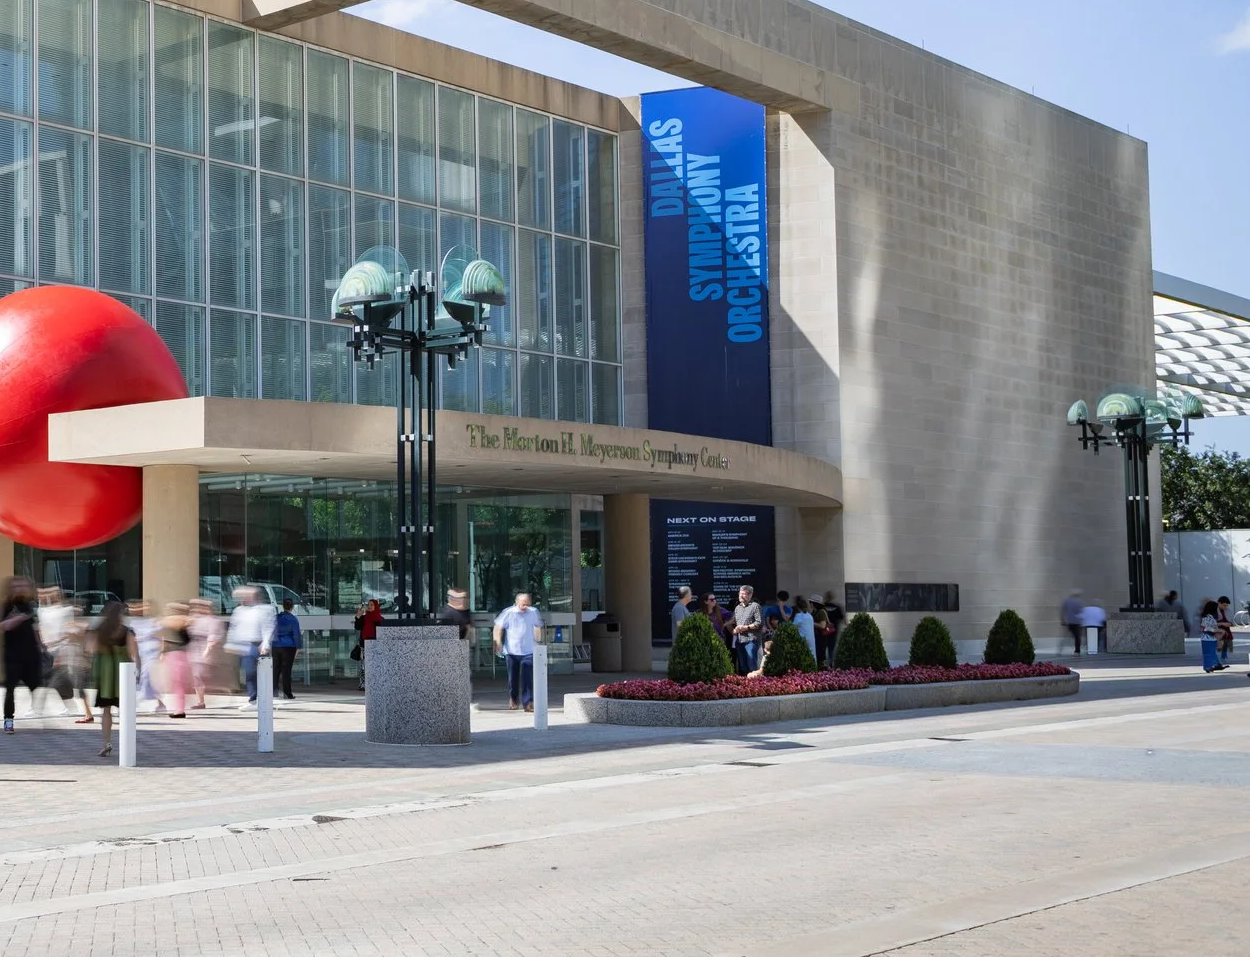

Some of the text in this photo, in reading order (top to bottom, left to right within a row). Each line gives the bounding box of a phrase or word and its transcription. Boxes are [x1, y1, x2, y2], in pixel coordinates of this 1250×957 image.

[649, 117, 684, 218] DALLAS
[686, 152, 724, 303] SYMPHONY
[725, 182, 764, 343] ORCHESTRA
[466, 424, 731, 472] The Morton H. Meyerson Symphony Center
